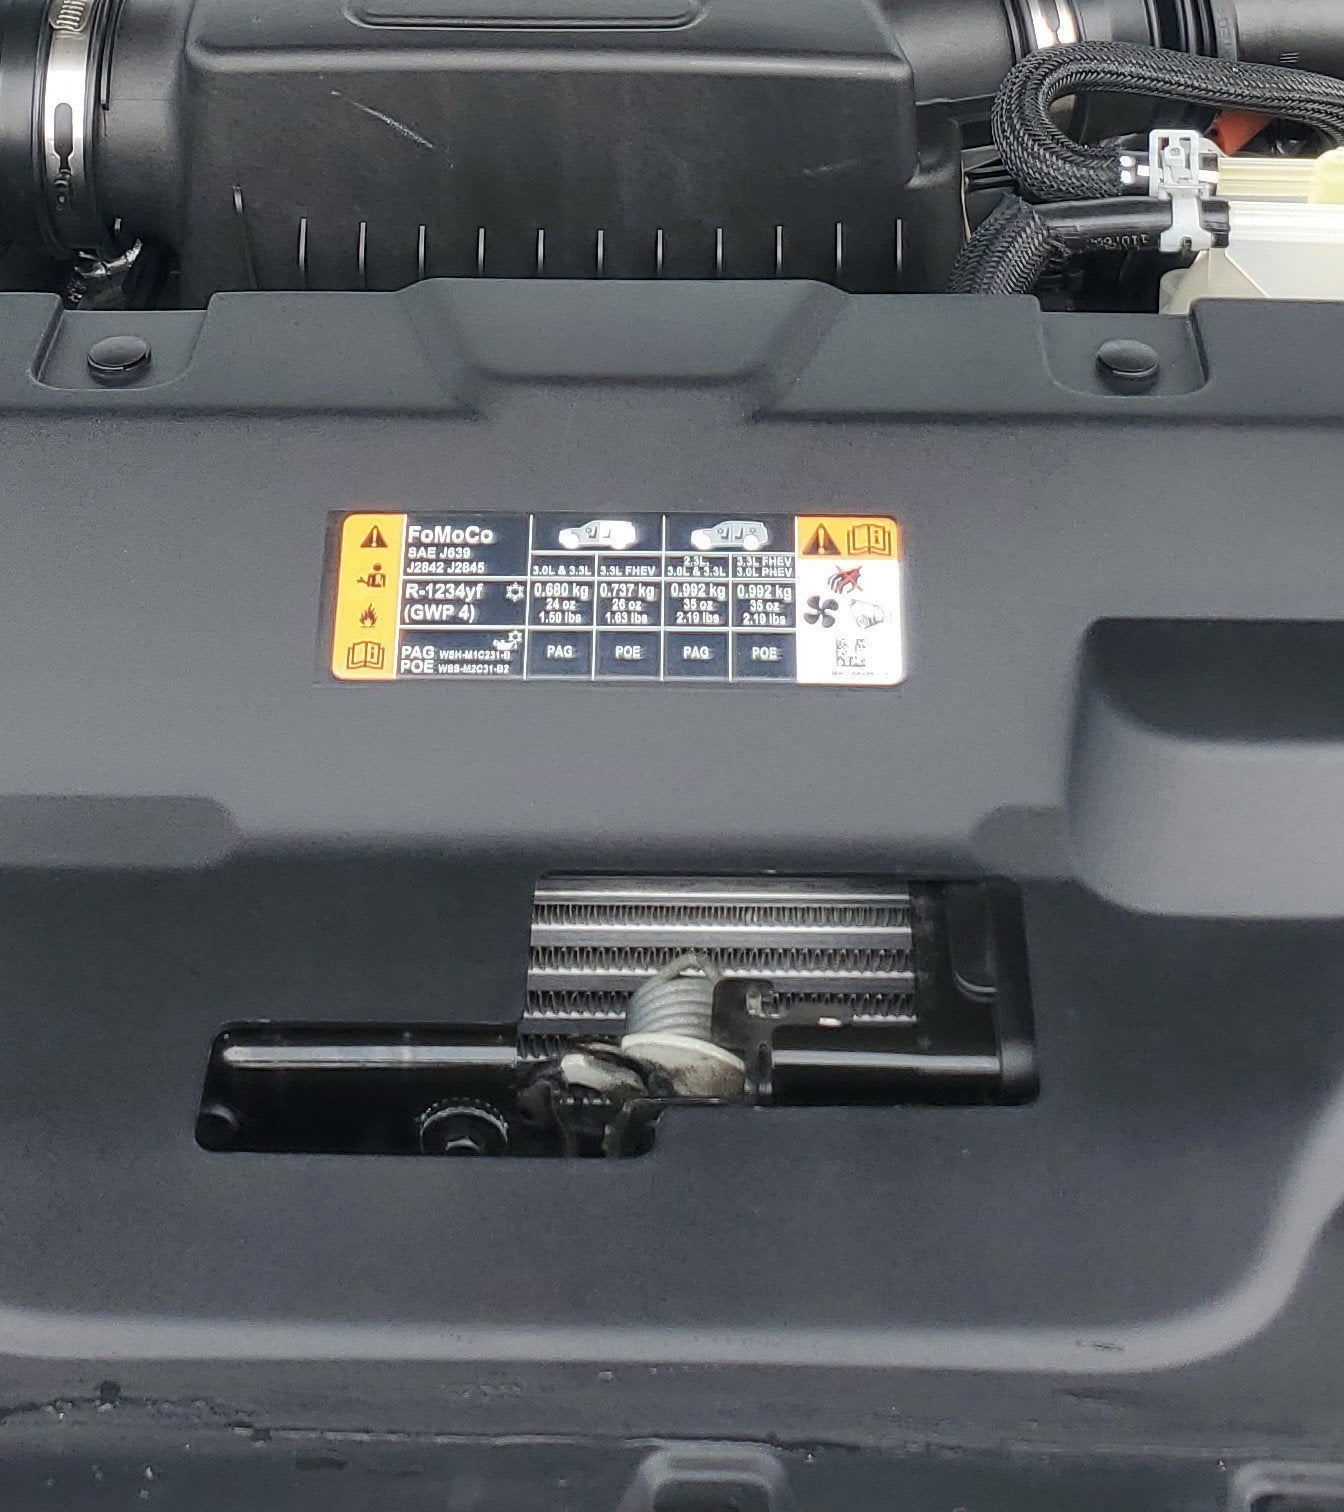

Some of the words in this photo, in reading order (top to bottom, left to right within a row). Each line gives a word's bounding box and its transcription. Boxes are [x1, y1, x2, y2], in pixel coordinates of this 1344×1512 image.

[408, 525, 494, 544] FoMoCo
[407, 546, 436, 559] SAE
[440, 546, 471, 559] J639
[737, 556, 759, 567] 3.3L
[762, 556, 792, 567] FHEV
[532, 565, 555, 575] 3.0L
[558, 565, 566, 575] &
[569, 565, 592, 576] 3.3L
[600, 565, 623, 576] 3.3L
[625, 565, 656, 576] FHEV
[667, 566, 690, 576] 3.0L
[693, 567, 700, 576] &
[704, 567, 726, 576] 3.3L
[737, 567, 759, 577] 3.0L
[762, 568, 792, 577] PHEV
[405, 583, 484, 602] R-1234yf
[534, 583, 569, 597] 0.680
[573, 583, 589, 601] kg
[600, 583, 635, 597] 0.737
[638, 583, 655, 601] kg
[670, 583, 706, 597] 0.992
[709, 583, 726, 601] kg
[775, 584, 792, 602] kg
[546, 598, 559, 610] 24
[563, 600, 576, 610] oz
[612, 598, 626, 611] 26
[628, 601, 642, 610] oz
[683, 598, 697, 611] 35
[699, 601, 713, 610] oz
[766, 602, 780, 611] oz
[404, 604, 455, 623] (GWP
[458, 604, 475, 623] 4)
[539, 611, 562, 623] 1.50
[564, 611, 582, 623] lbs
[605, 611, 628, 624] 1.63
[631, 612, 648, 624] lbs
[676, 611, 700, 624] 2.19
[703, 612, 720, 624] lbs
[769, 613, 786, 625] lbs
[401, 645, 435, 659] PAG
[547, 645, 573, 658] PAG
[615, 645, 641, 659] POE
[683, 645, 709, 659] PAG
[752, 646, 778, 660] POE
[400, 660, 434, 673] POE
